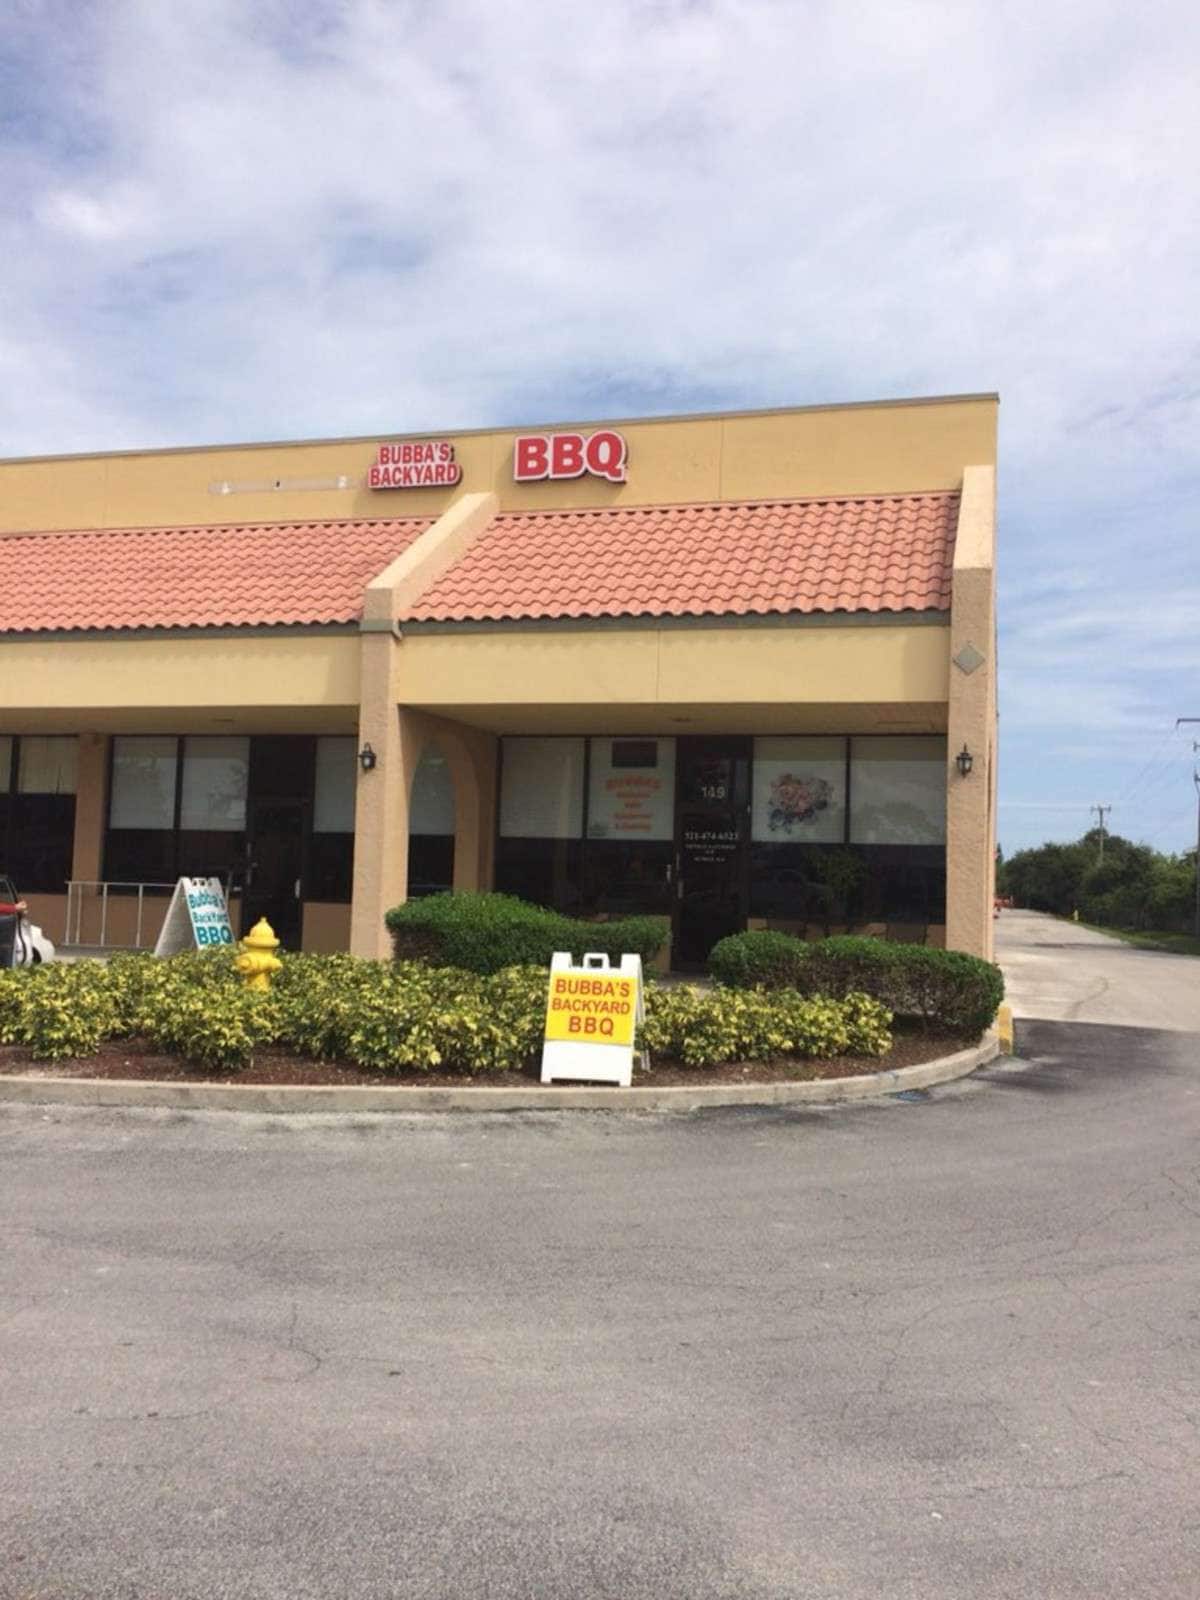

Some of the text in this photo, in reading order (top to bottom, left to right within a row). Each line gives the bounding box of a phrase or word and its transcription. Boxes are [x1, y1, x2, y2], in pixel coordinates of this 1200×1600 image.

[380, 442, 450, 464] BUBBA'S
[516, 432, 624, 478] BBQ
[370, 463, 458, 486] BACKYARD
[196, 925, 233, 944] BBQ
[555, 978, 631, 998] BUBBA'S
[551, 997, 631, 1015] BACKYARD
[568, 1015, 615, 1037] BBQ
